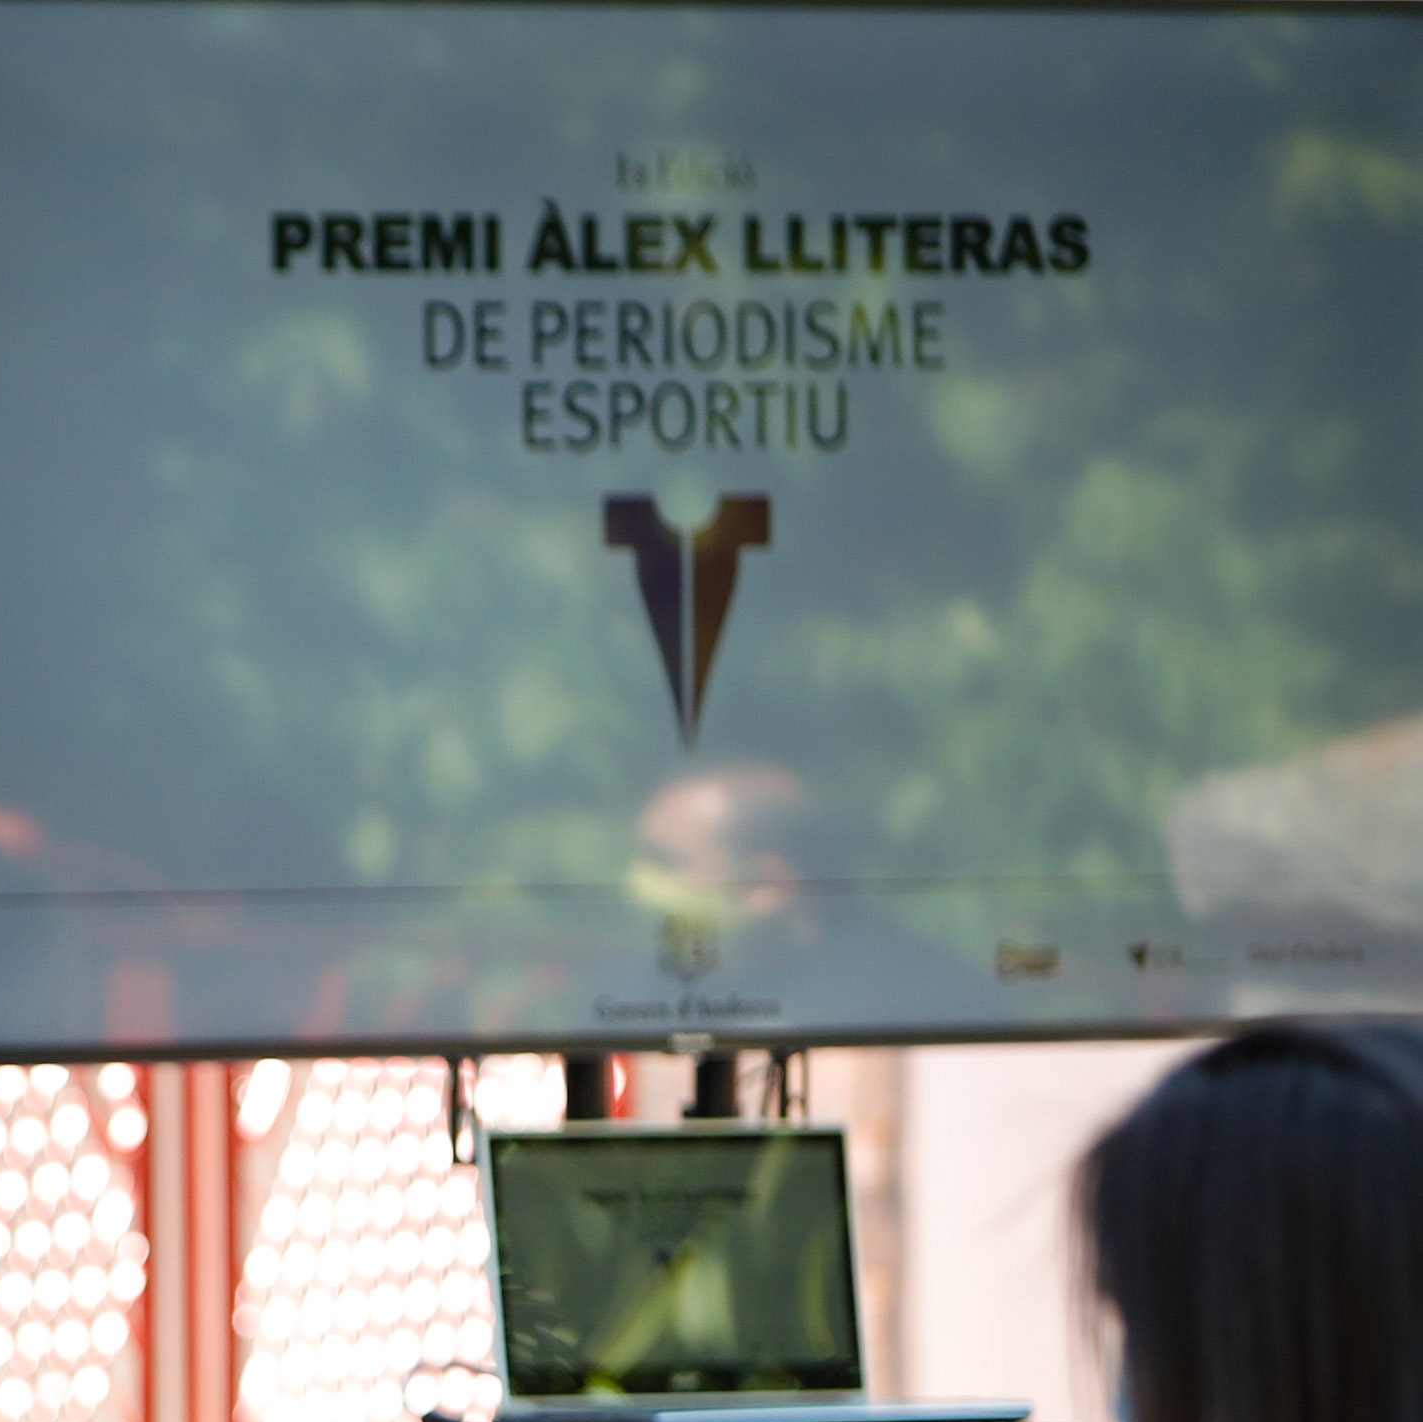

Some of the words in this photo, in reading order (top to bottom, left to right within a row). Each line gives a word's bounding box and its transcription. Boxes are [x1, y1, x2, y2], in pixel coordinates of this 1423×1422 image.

[271, 212, 502, 274] PREMI
[529, 197, 720, 274] ÀLEX
[743, 212, 1092, 275] LLITERAS
[423, 301, 508, 370] DE
[531, 300, 947, 370] PERIODISME
[521, 381, 850, 452] ESPORTIU
